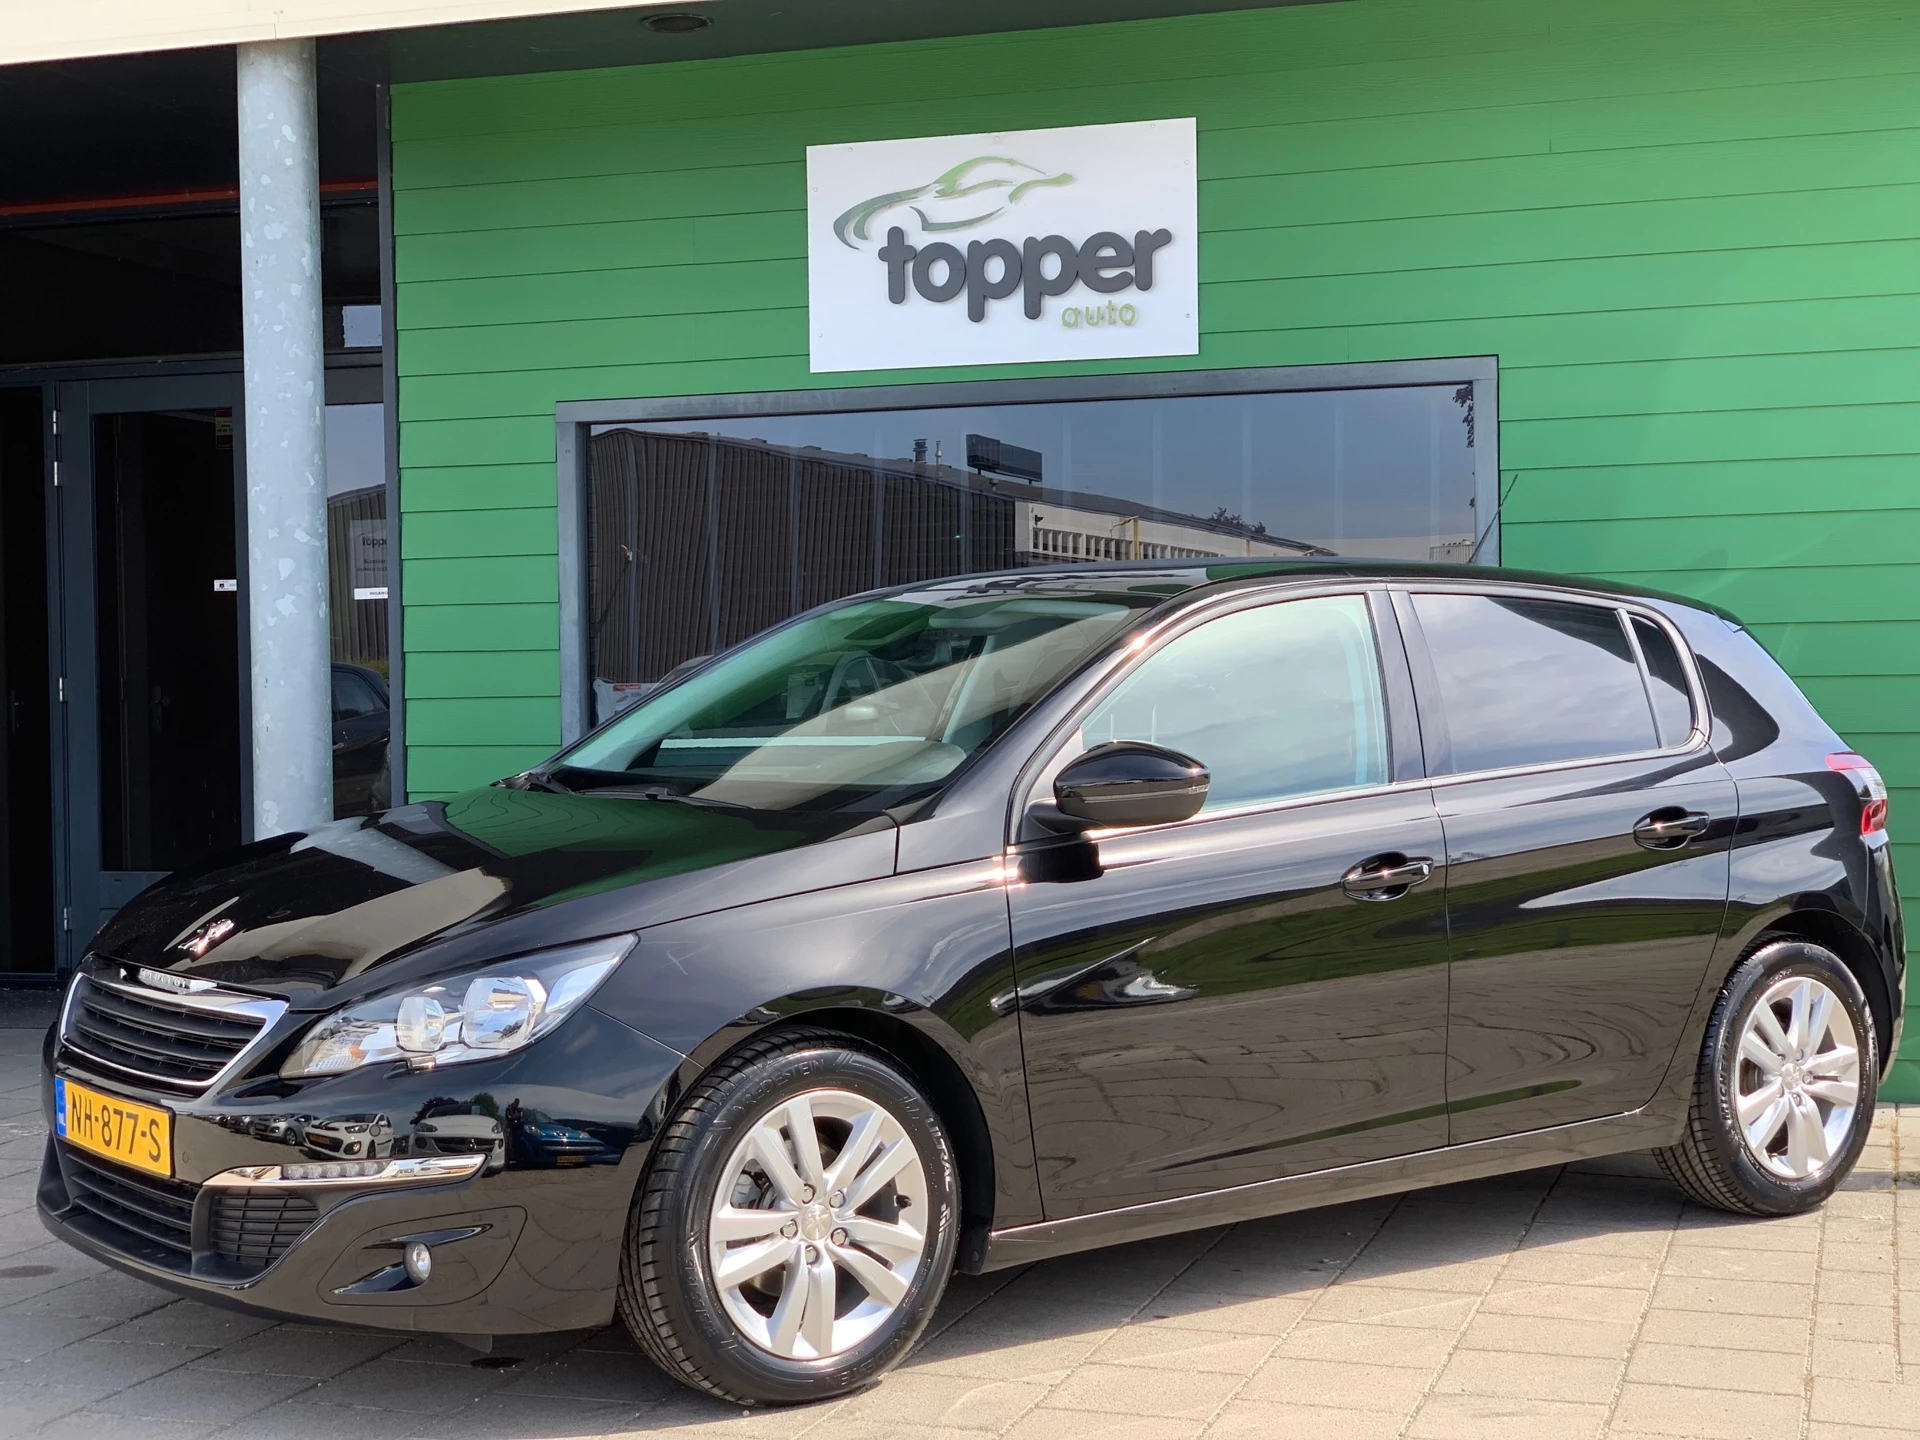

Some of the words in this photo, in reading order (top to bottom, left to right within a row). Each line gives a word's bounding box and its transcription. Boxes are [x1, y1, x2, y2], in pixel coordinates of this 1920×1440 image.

[878, 226, 1172, 323] topper
[1061, 300, 1137, 328] auto
[362, 536, 387, 549] topp
[71, 1091, 161, 1163] NH-877-S
